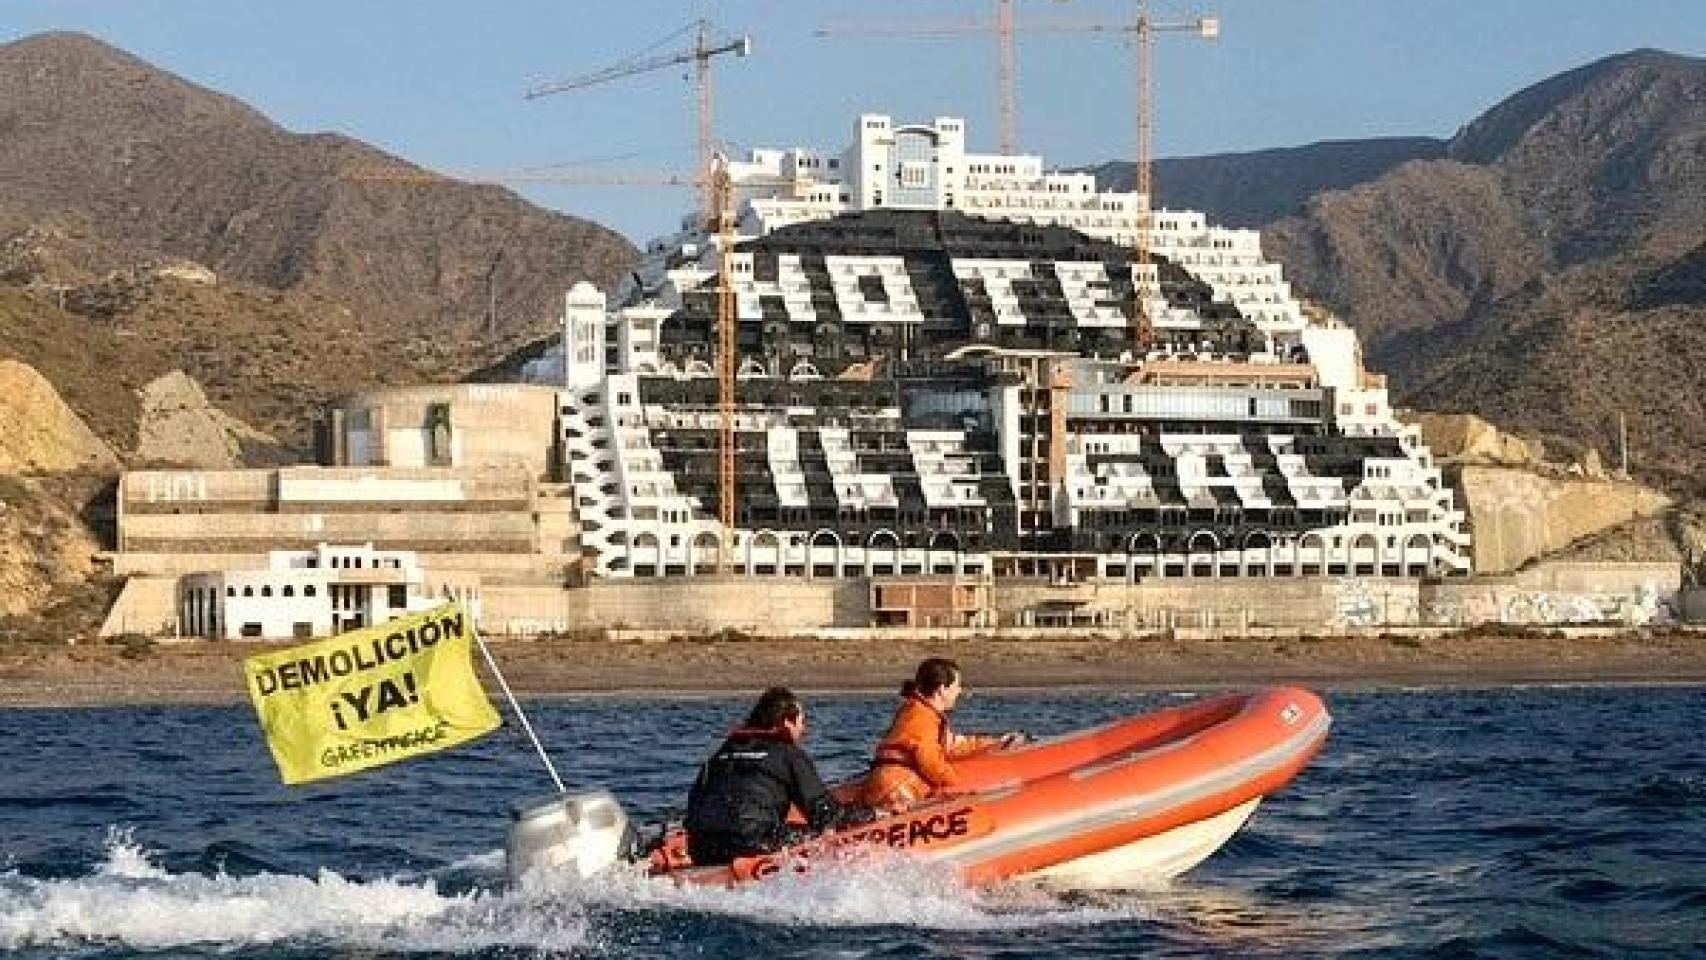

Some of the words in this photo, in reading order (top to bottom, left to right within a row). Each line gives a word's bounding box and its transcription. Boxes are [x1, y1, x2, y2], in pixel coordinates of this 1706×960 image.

[731, 253, 1202, 328] HOTEL
[767, 426, 1348, 510] ILEGAL
[255, 612, 466, 697] DEMOLICIÓN
[330, 671, 420, 731] ¡YA!
